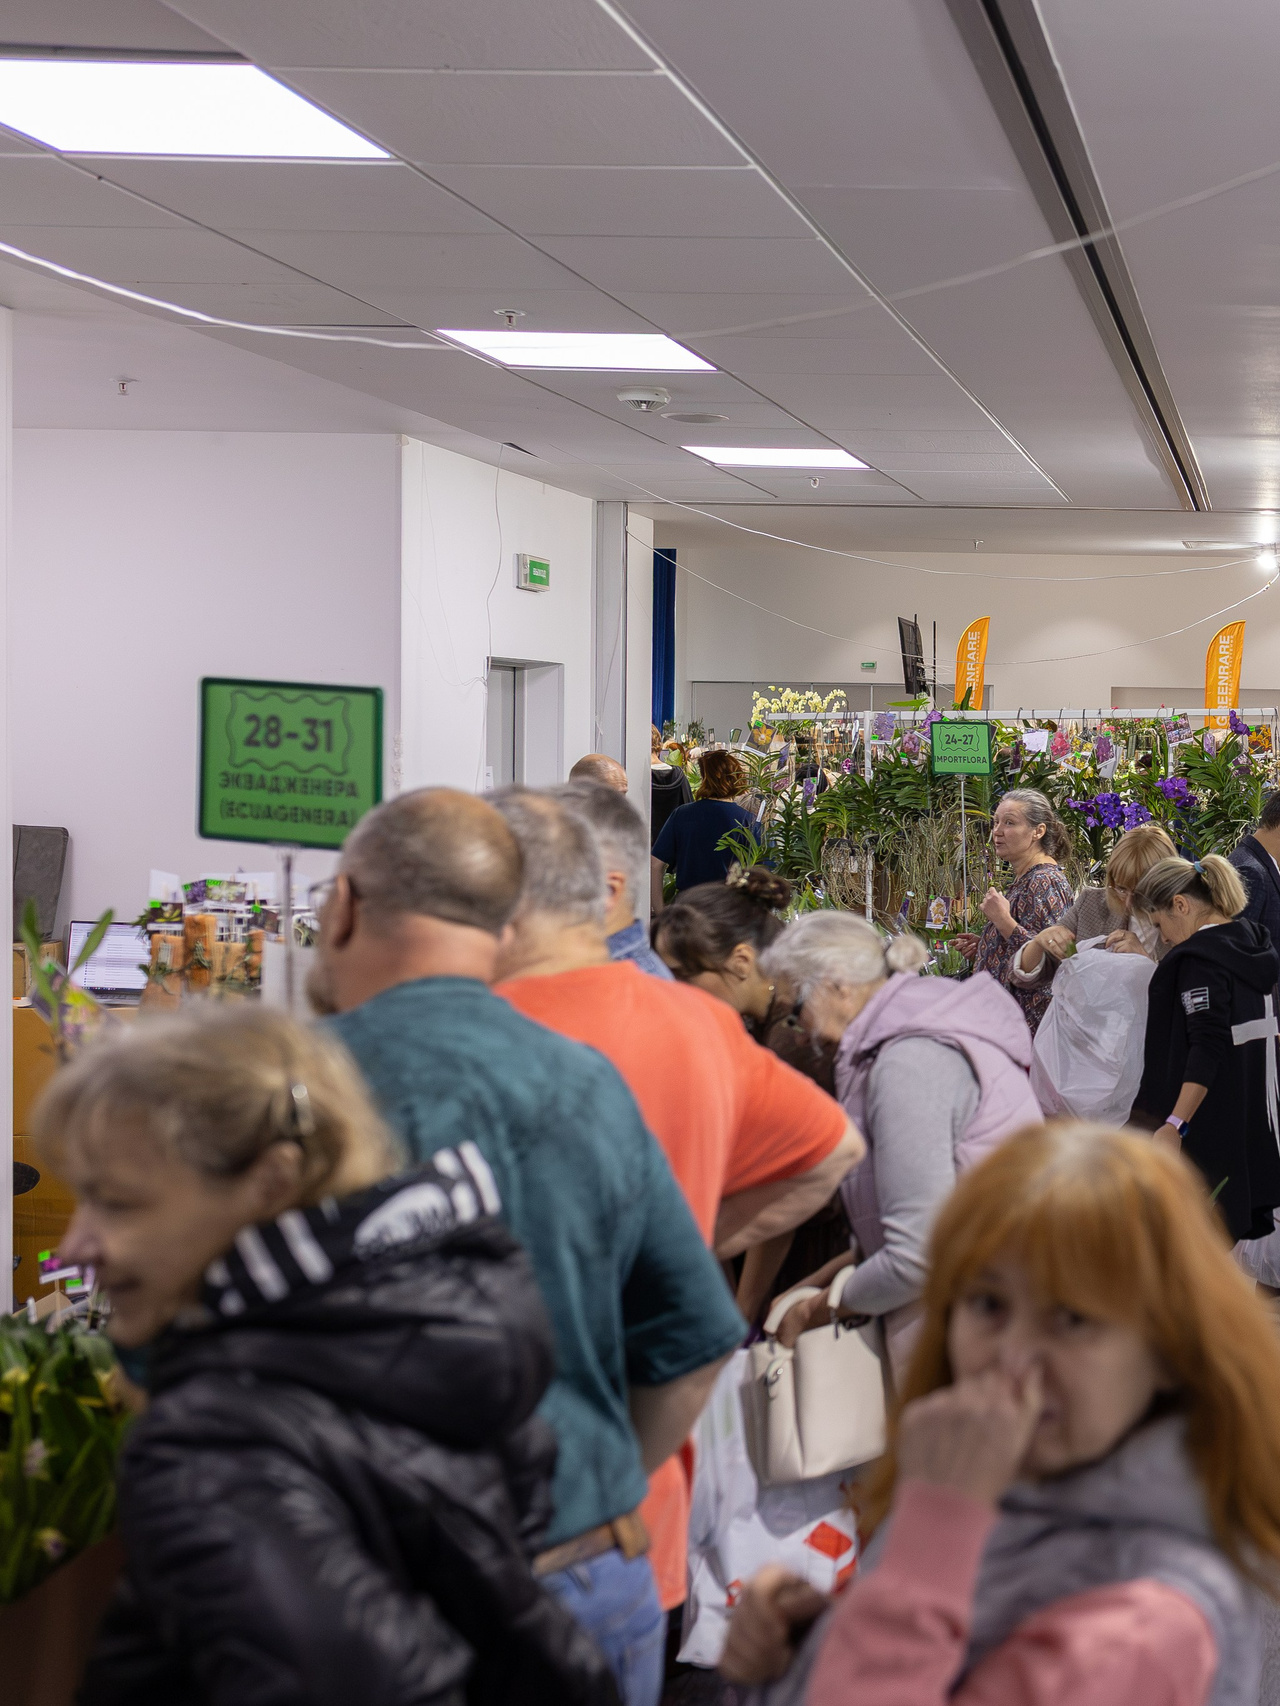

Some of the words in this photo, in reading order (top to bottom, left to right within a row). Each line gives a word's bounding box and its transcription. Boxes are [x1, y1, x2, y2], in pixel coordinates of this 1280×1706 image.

[244, 714, 333, 752] 28-31
[944, 733, 974, 745] 24-27
[934, 755, 988, 764] IMPORTFLORA
[219, 771, 358, 798] ЭКВАДЖЕНЕРА
